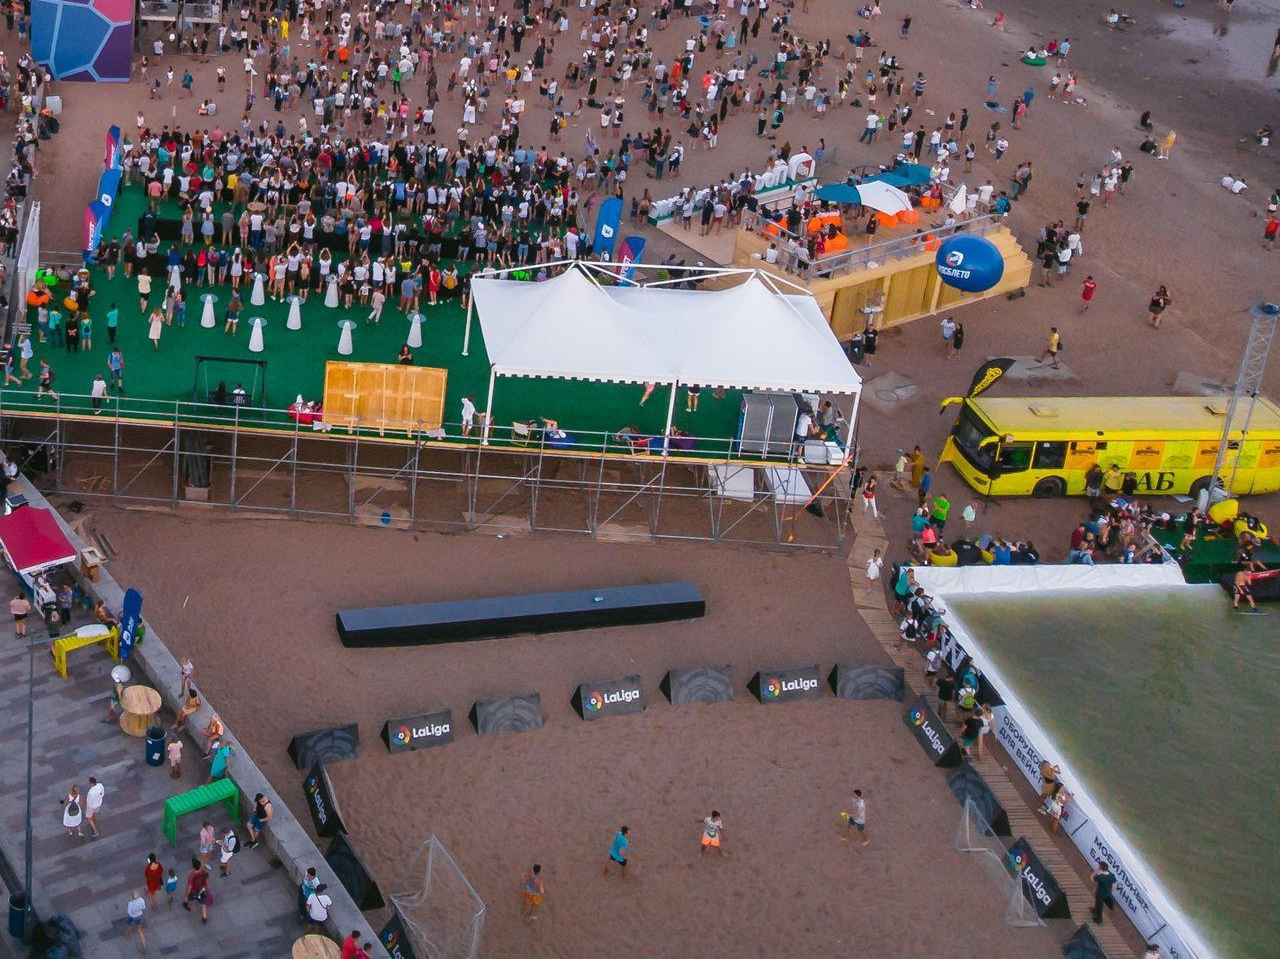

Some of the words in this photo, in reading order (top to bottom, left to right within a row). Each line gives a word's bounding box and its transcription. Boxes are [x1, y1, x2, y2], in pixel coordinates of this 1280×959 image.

[604, 689, 640, 704] LaLiga
[782, 677, 817, 692] LaLiga
[412, 723, 450, 739] LaLiga
[921, 720, 946, 755] LaLiga
[999, 727, 1016, 750] ДЛЯ
[1015, 748, 1044, 784] ВЕЙК-П
[1023, 865, 1052, 906] LaLiga
[1089, 847, 1137, 913] БАЙНЫ
[1093, 836, 1150, 914] МОБИЛЬНЫЕ
